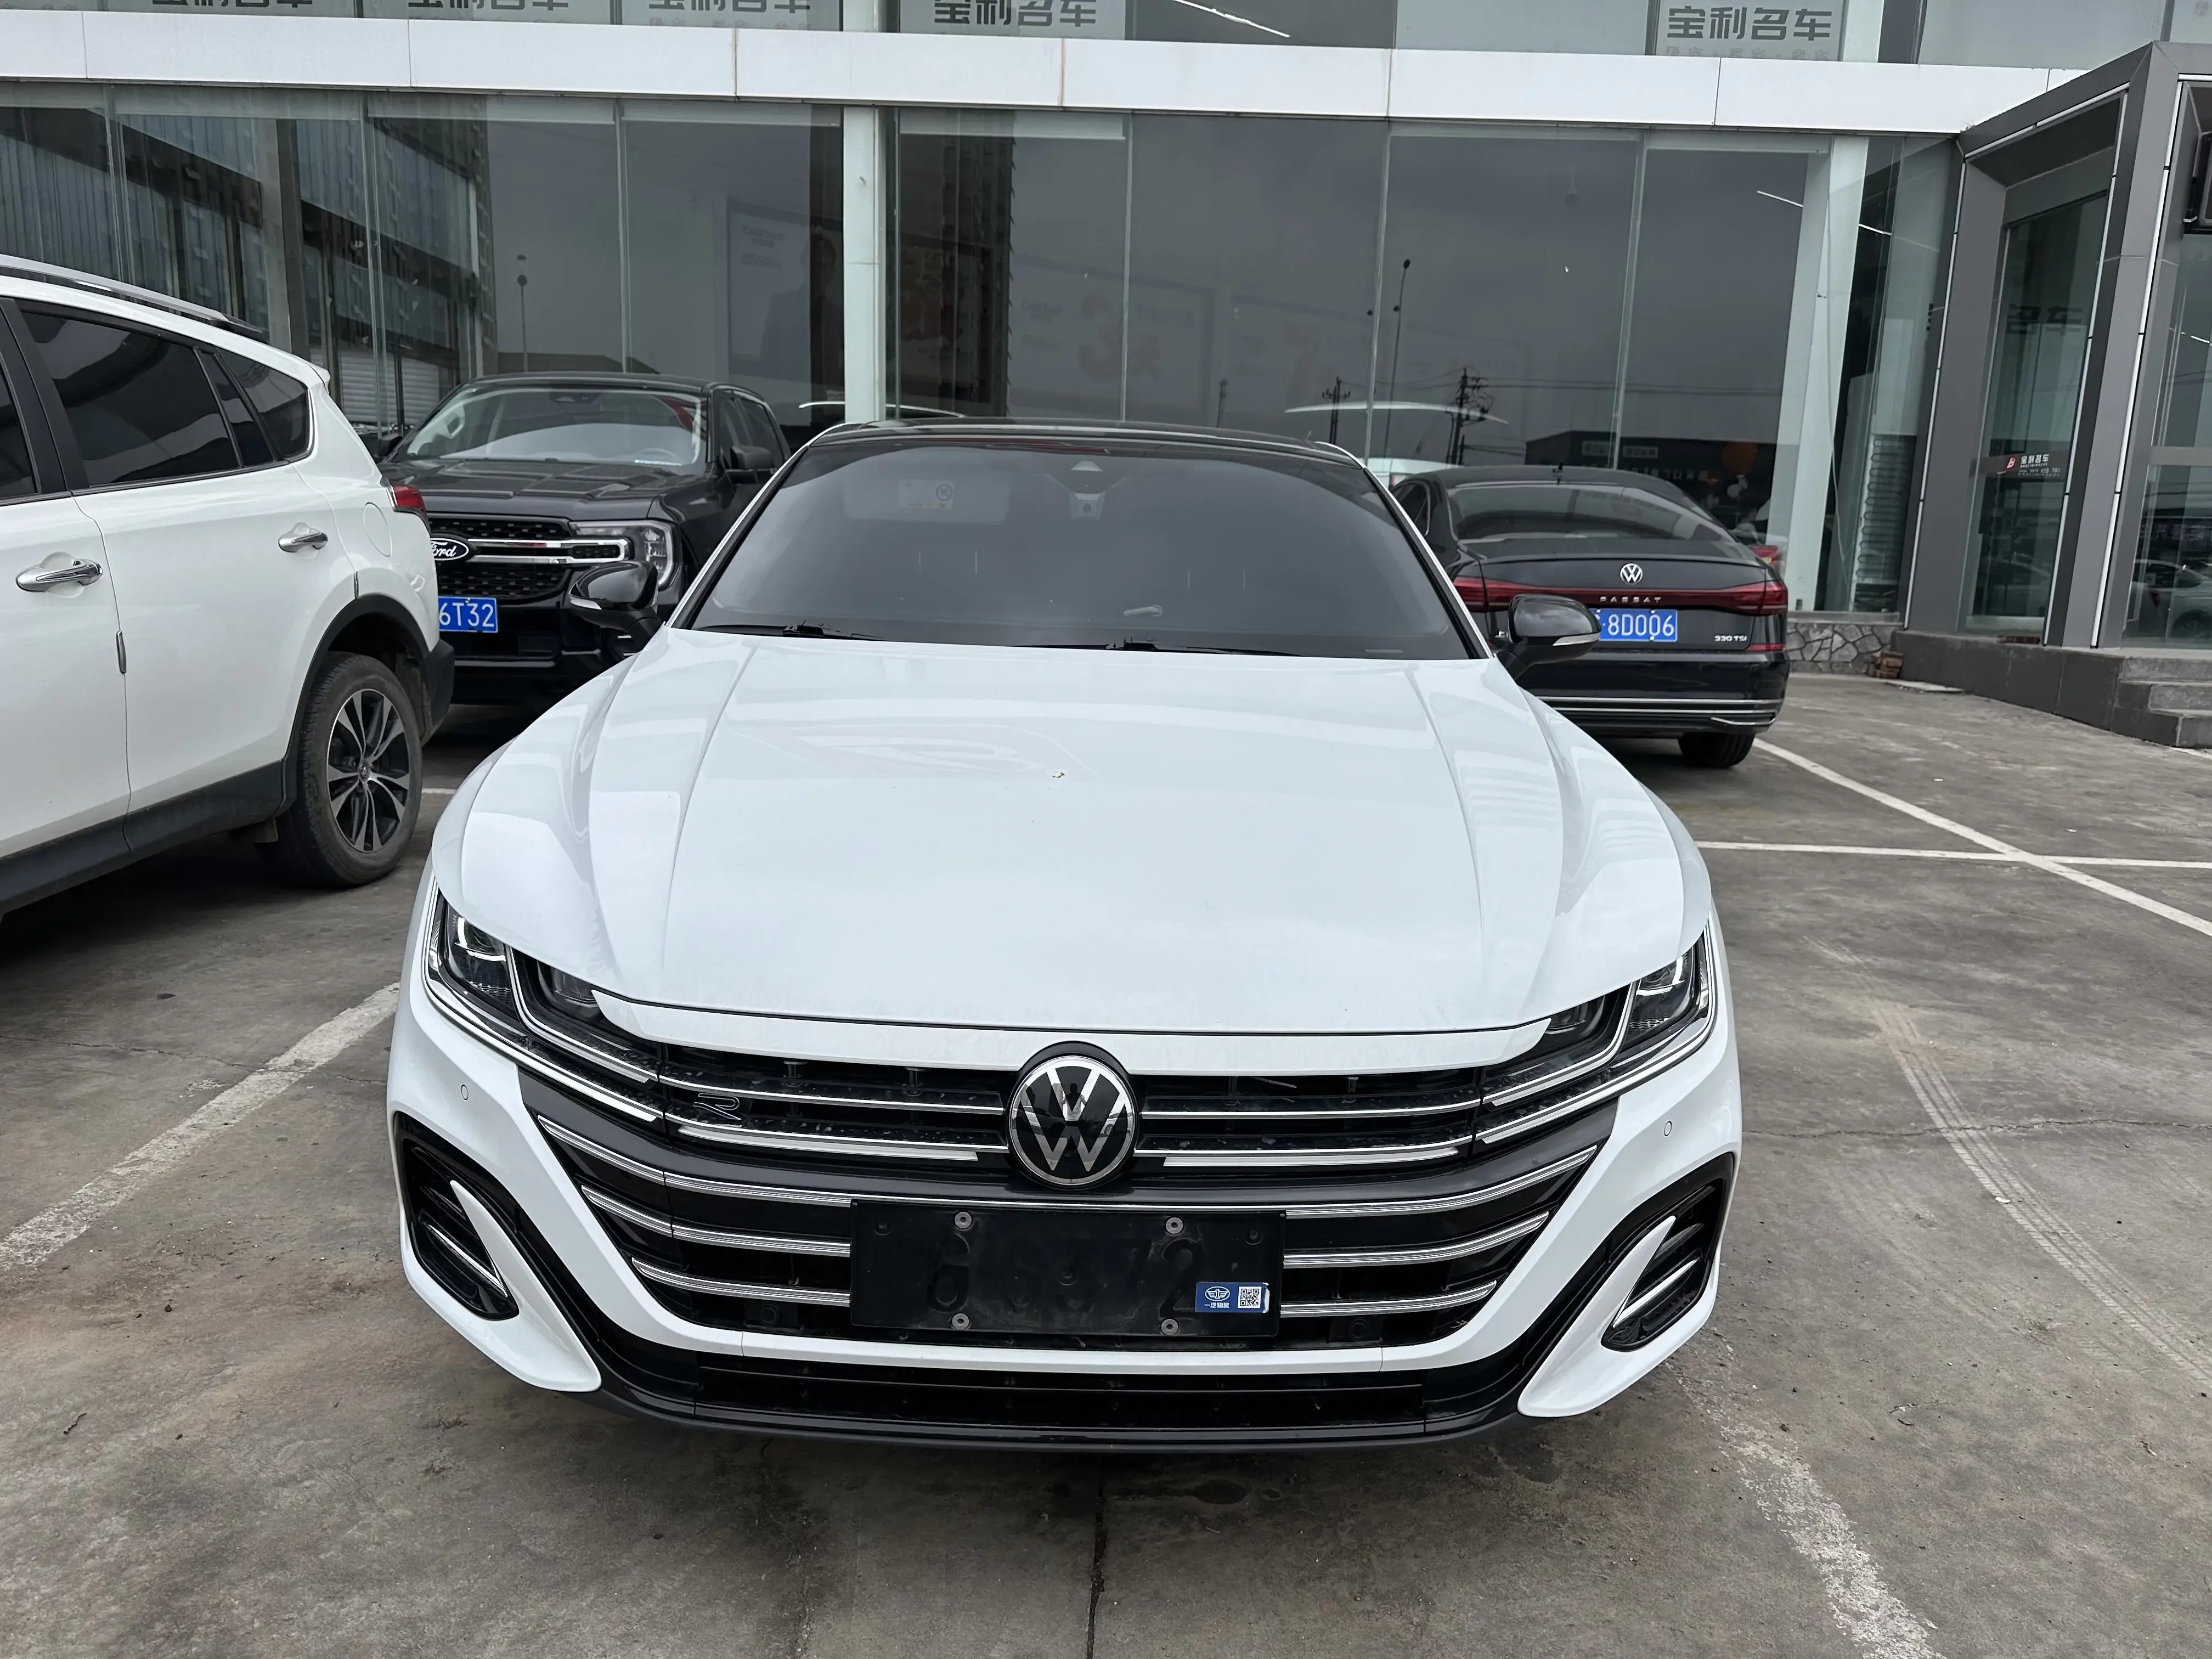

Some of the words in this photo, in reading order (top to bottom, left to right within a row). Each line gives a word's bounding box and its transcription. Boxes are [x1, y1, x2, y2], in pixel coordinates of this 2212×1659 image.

[1667, 5, 1832, 41] 宝利名车
[1011, 1059, 1134, 1181] VW
